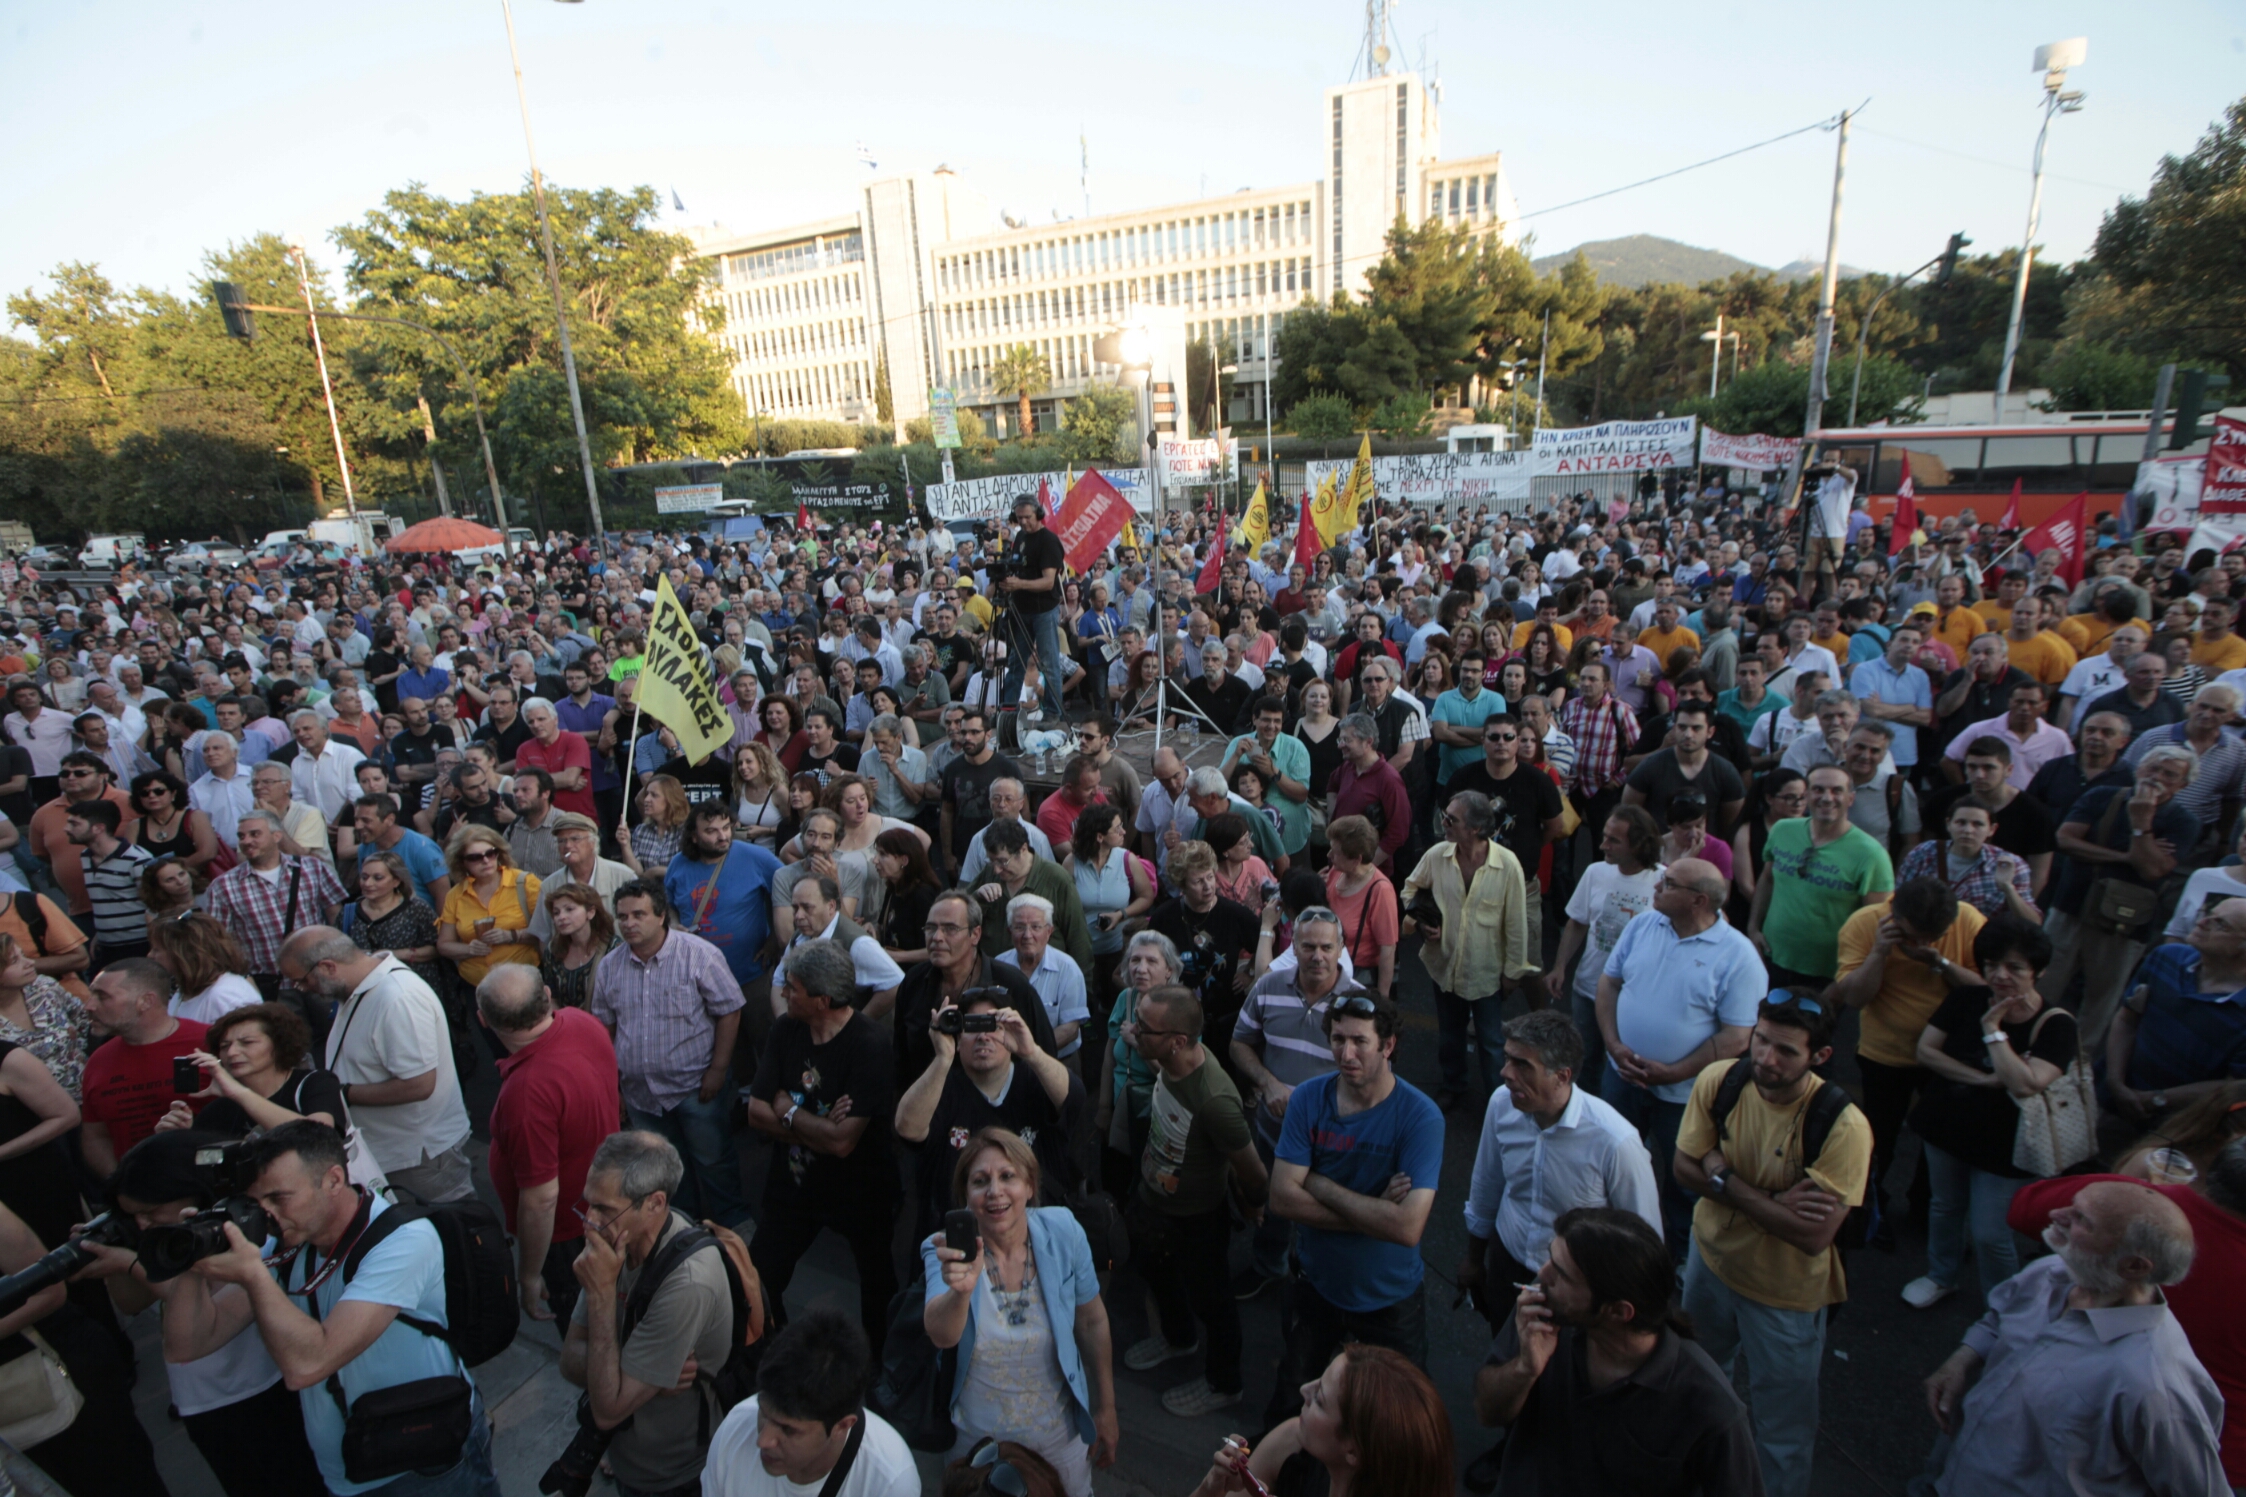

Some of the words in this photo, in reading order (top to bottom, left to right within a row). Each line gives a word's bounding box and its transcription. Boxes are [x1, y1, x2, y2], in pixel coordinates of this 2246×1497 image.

[1533, 431, 1558, 444] ΤΗΝ
[1561, 429, 1593, 442] ΚΡΙΣΗ
[1595, 425, 1611, 437] ΝΑ
[1614, 419, 1690, 436] ΠΛΗΡΩΣΟΥΝ
[1557, 438, 1669, 459] ΚΑΠΙΤΑΛΙΣΤΕΣ
[1557, 451, 1675, 473] ΑΝΤΑΡΣΥΑ
[933, 480, 970, 501] ΟΤΑΝ
[977, 479, 988, 496] Η
[1400, 479, 1434, 493] ΜΕΧΡΙ
[1441, 478, 1454, 492] ΤΗ
[873, 493, 890, 506] ΕΡΤ
